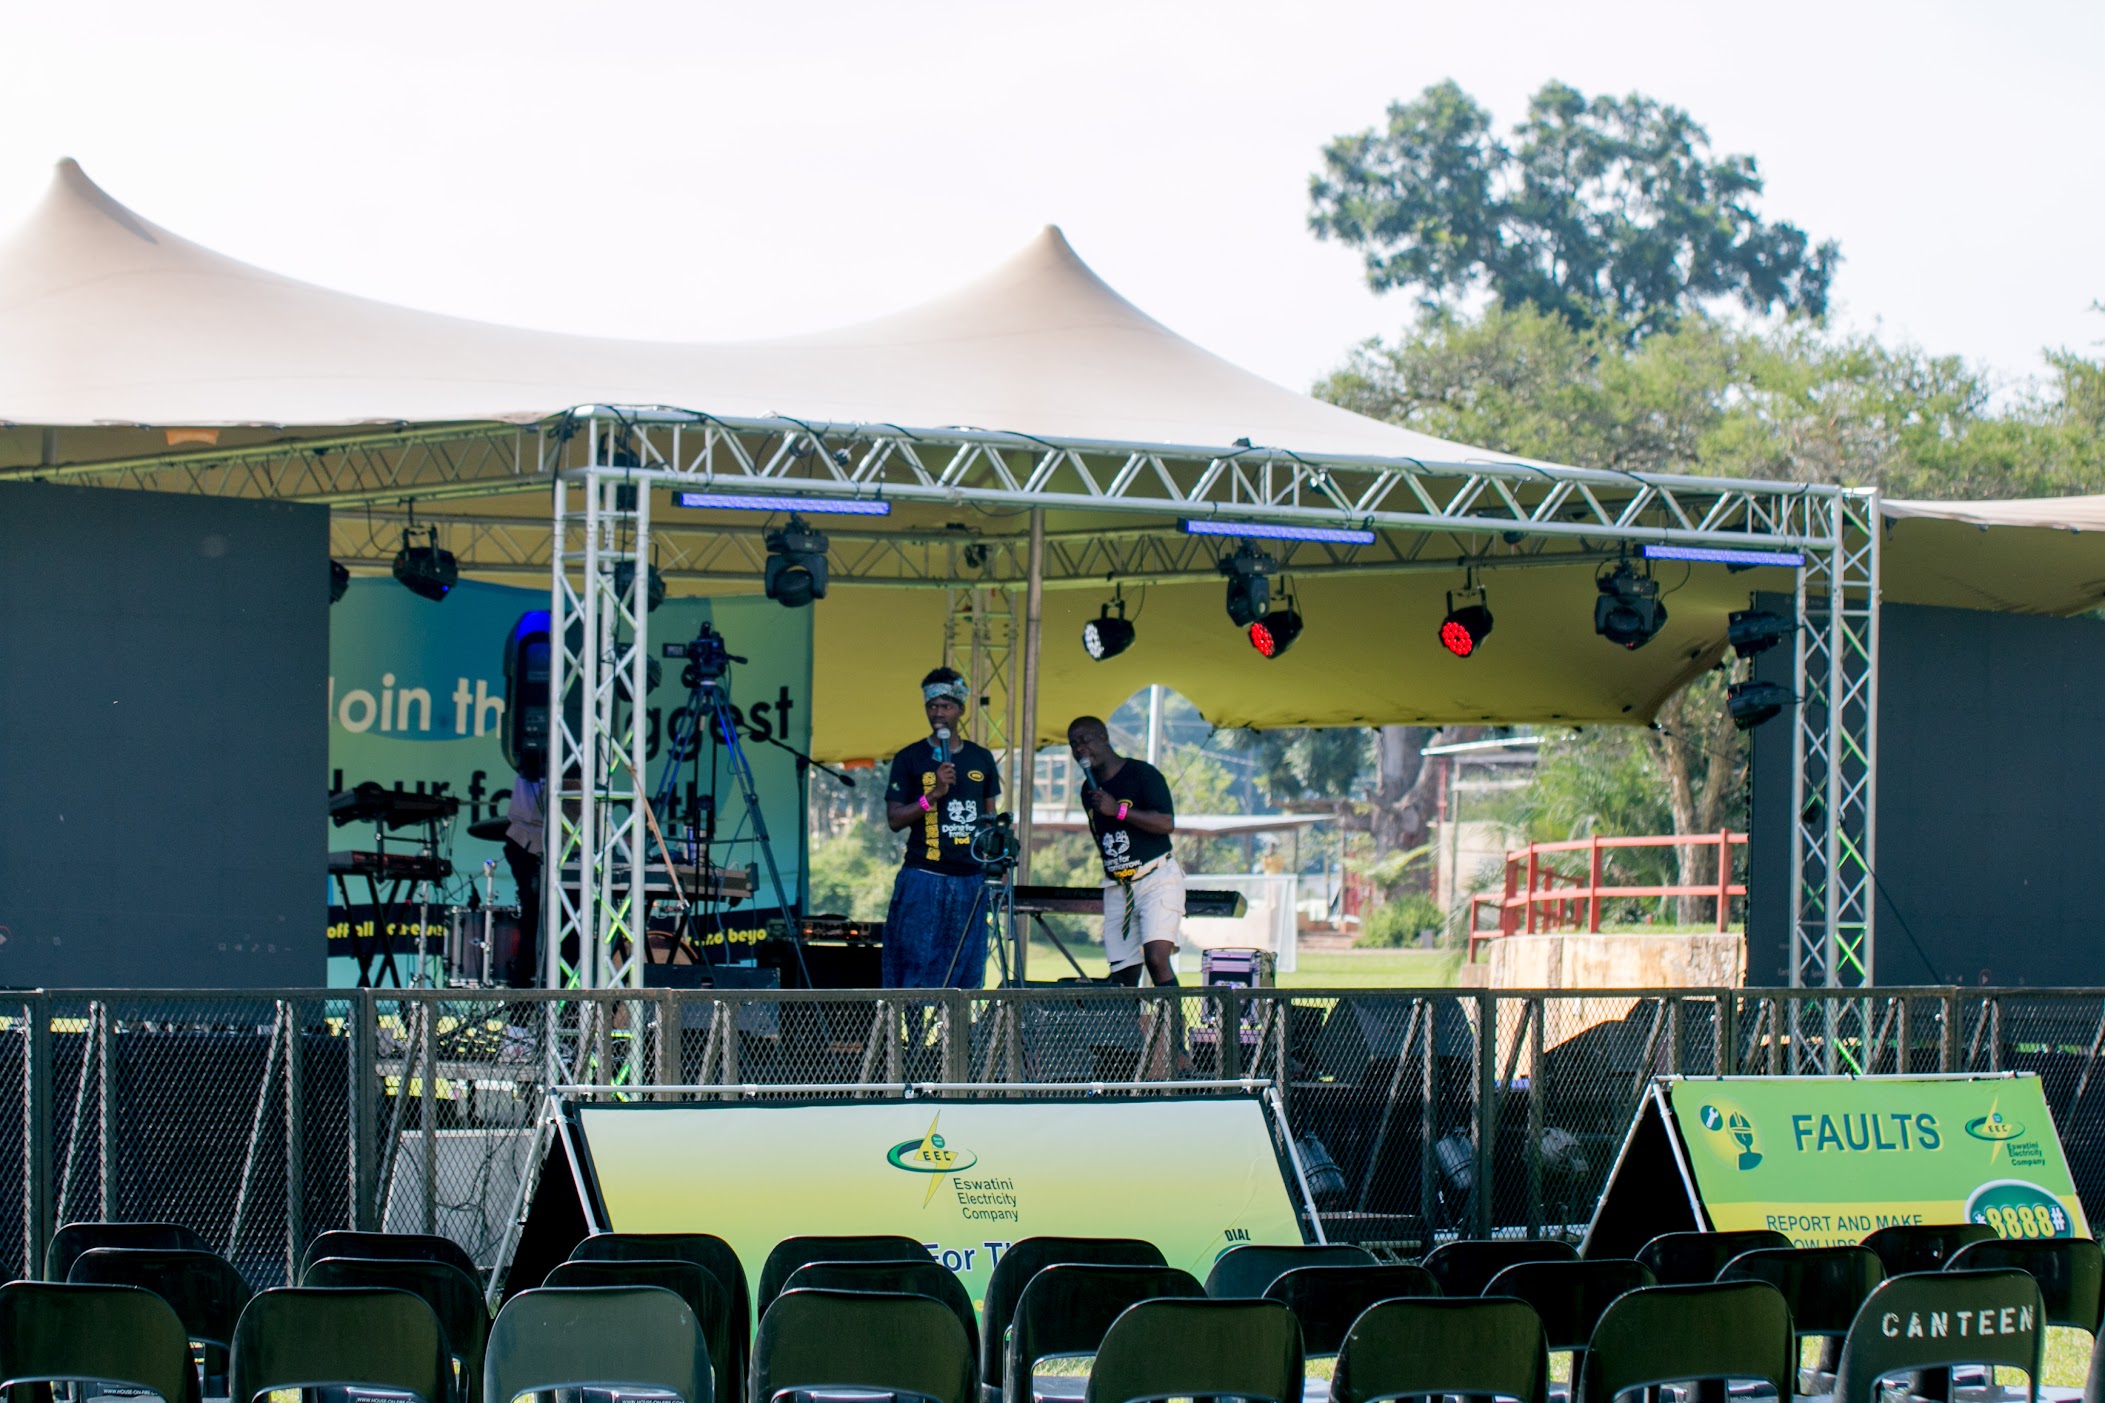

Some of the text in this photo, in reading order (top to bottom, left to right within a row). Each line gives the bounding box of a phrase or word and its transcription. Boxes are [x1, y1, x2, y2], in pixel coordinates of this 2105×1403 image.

[453, 677, 506, 739] th
[1791, 1112, 1944, 1152] FAULTS
[1988, 1125, 2008, 1133] EEC
[2006, 1142, 2039, 1151] Eswatini
[2008, 1149, 2043, 1157] Electricity
[923, 1150, 952, 1161] EEC
[2011, 1158, 2046, 1167] Company
[953, 1177, 1014, 1190] Eswatini
[957, 1192, 1017, 1208] Electricity
[962, 1207, 1019, 1223] Company
[1766, 1214, 1923, 1231] REPORT AND MAKE
[1224, 1228, 1251, 1242] DIAL
[1881, 1304, 2034, 1338] CANTEEN
